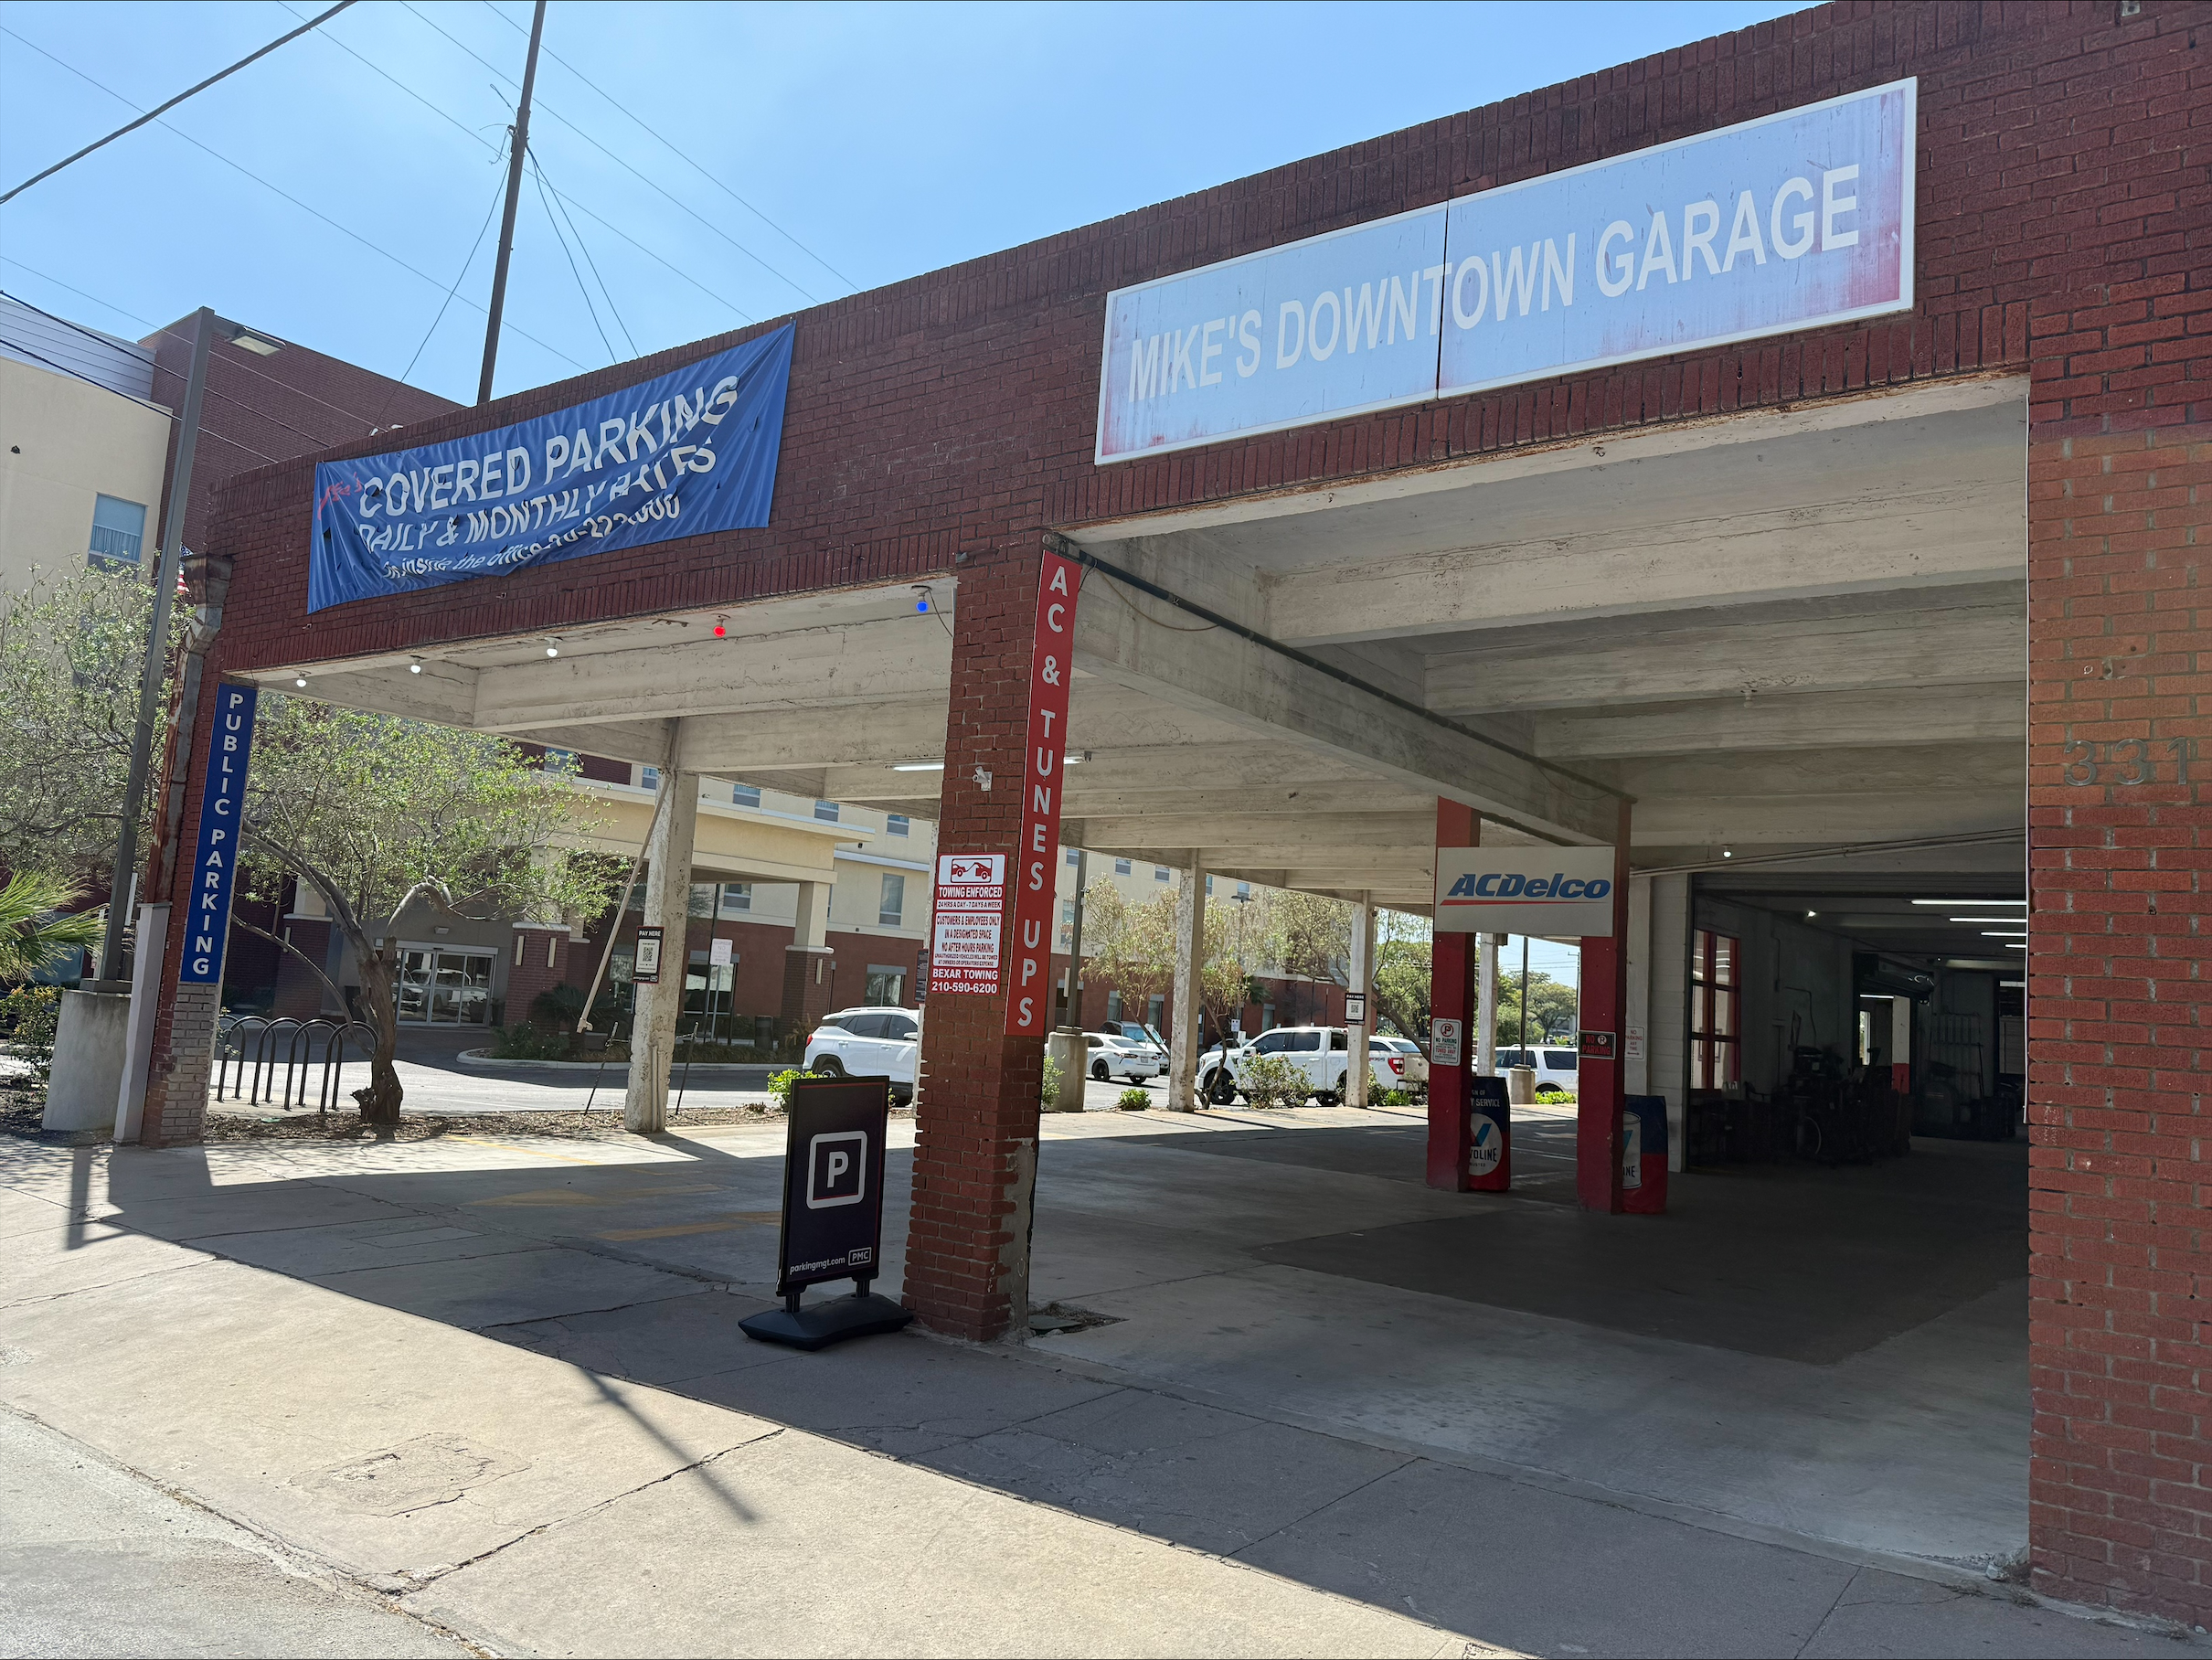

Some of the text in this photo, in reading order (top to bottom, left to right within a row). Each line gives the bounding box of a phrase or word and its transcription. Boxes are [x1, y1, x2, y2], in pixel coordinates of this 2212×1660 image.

[1129, 164, 1859, 403] MIKE'S DOWNTOWN GARAGE
[359, 375, 739, 518] COVERED PARKING
[359, 520, 439, 554] DAILY
[436, 516, 459, 547] &
[464, 480, 607, 544] MONTHLY
[452, 554, 485, 569] the
[2064, 737, 2186, 786] 331
[1017, 566, 1069, 1027] AC & TUNES UPS
[192, 692, 244, 975] PUBLIC PARKING
[938, 886, 1003, 898] TOWING ENFORCED
[1447, 873, 1611, 899] ACDelco
[937, 915, 961, 925] CUSTOMERS
[965, 916, 988, 925] EMPLOYEES
[989, 916, 1000, 925] ONLY
[944, 929, 992, 939] IN A DESIGNATED SPACE
[941, 942, 994, 952] NO AFTER HOURS PARKING
[932, 968, 998, 980] BEXAR TOWING
[931, 981, 998, 994] 210-590-6200
[1586, 1035, 1595, 1044] NO
[1582, 1045, 1611, 1055] PARKING
[1475, 1098, 1500, 1107] SERVICE
[790, 1250, 868, 1275] parkingmgt.com PMC
